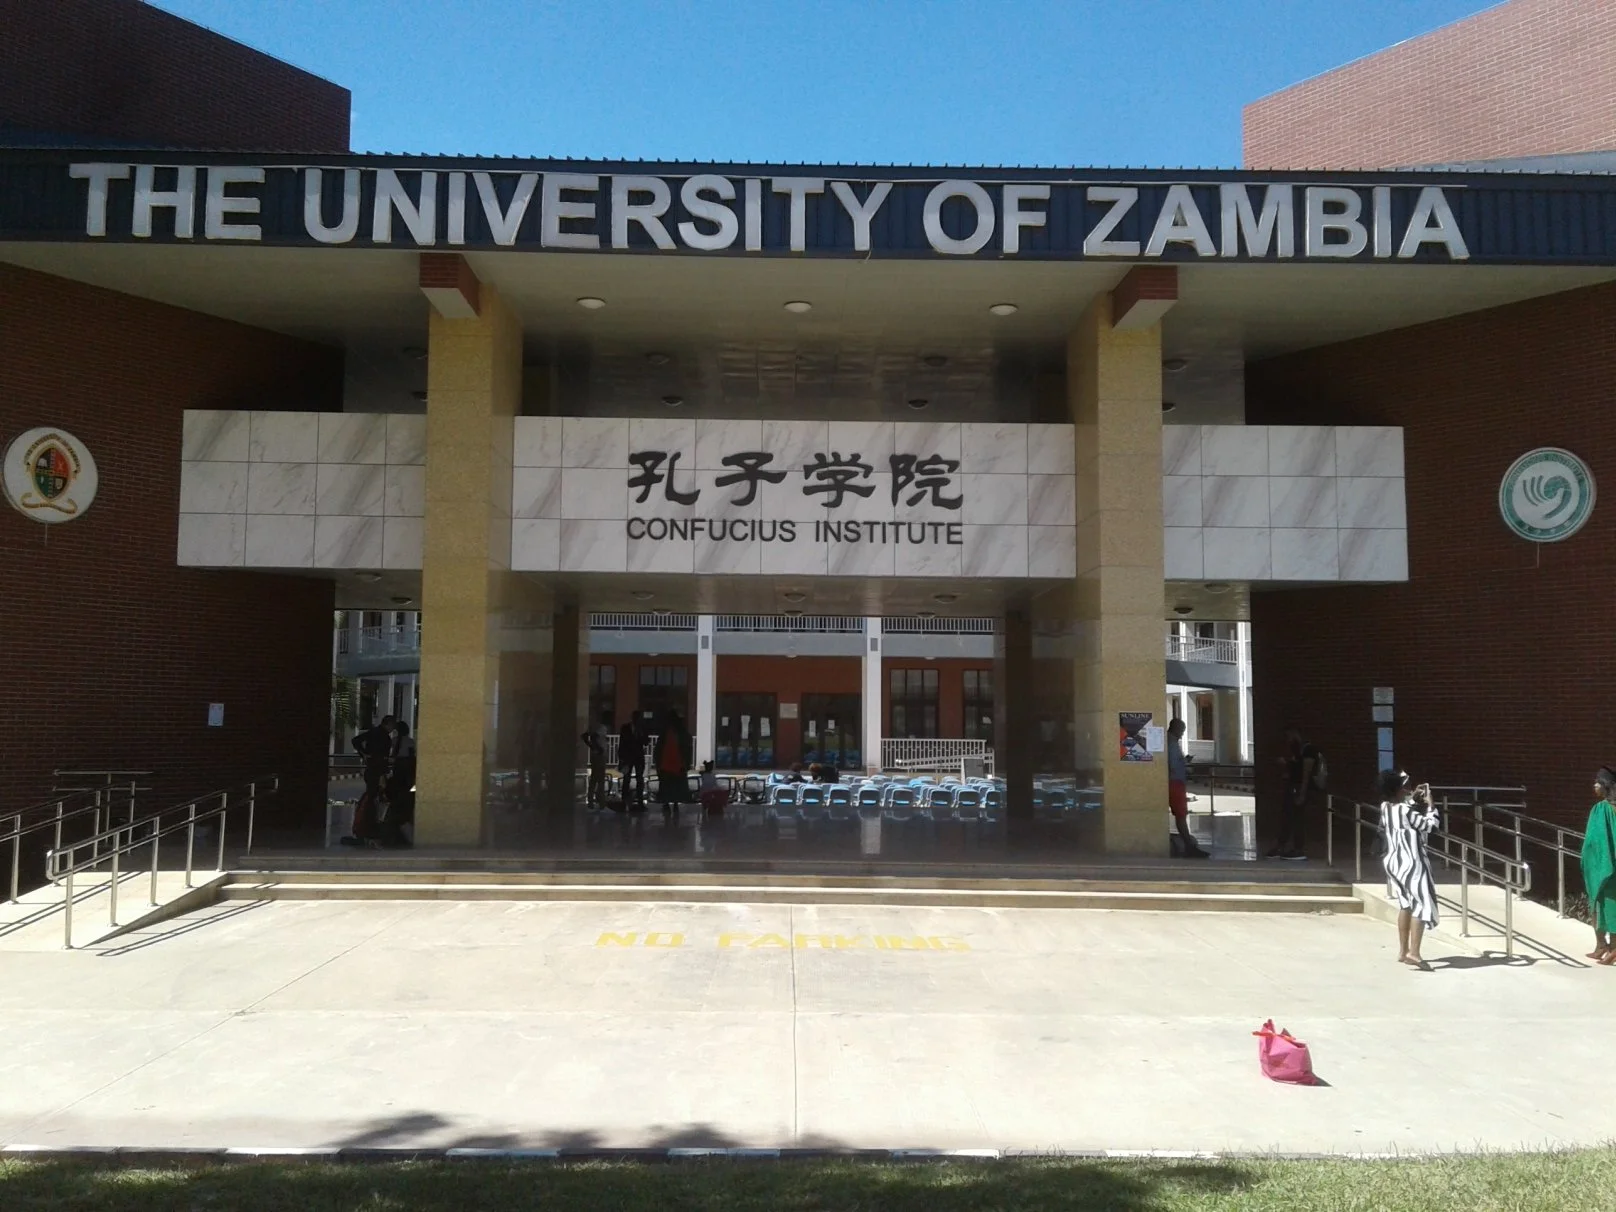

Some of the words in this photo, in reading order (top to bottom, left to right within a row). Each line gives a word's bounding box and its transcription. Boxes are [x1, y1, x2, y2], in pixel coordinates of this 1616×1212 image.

[69, 162, 265, 241] THE
[303, 166, 894, 252] UNIVERSITY
[922, 179, 1050, 255] OF
[1083, 183, 1470, 260] ZAMBIA
[628, 450, 964, 511] 孔子学院
[626, 517, 796, 543] CONFUCIUS
[815, 520, 964, 545] INSTITUTE
[596, 932, 686, 947] NO
[717, 933, 972, 950] PARKING
